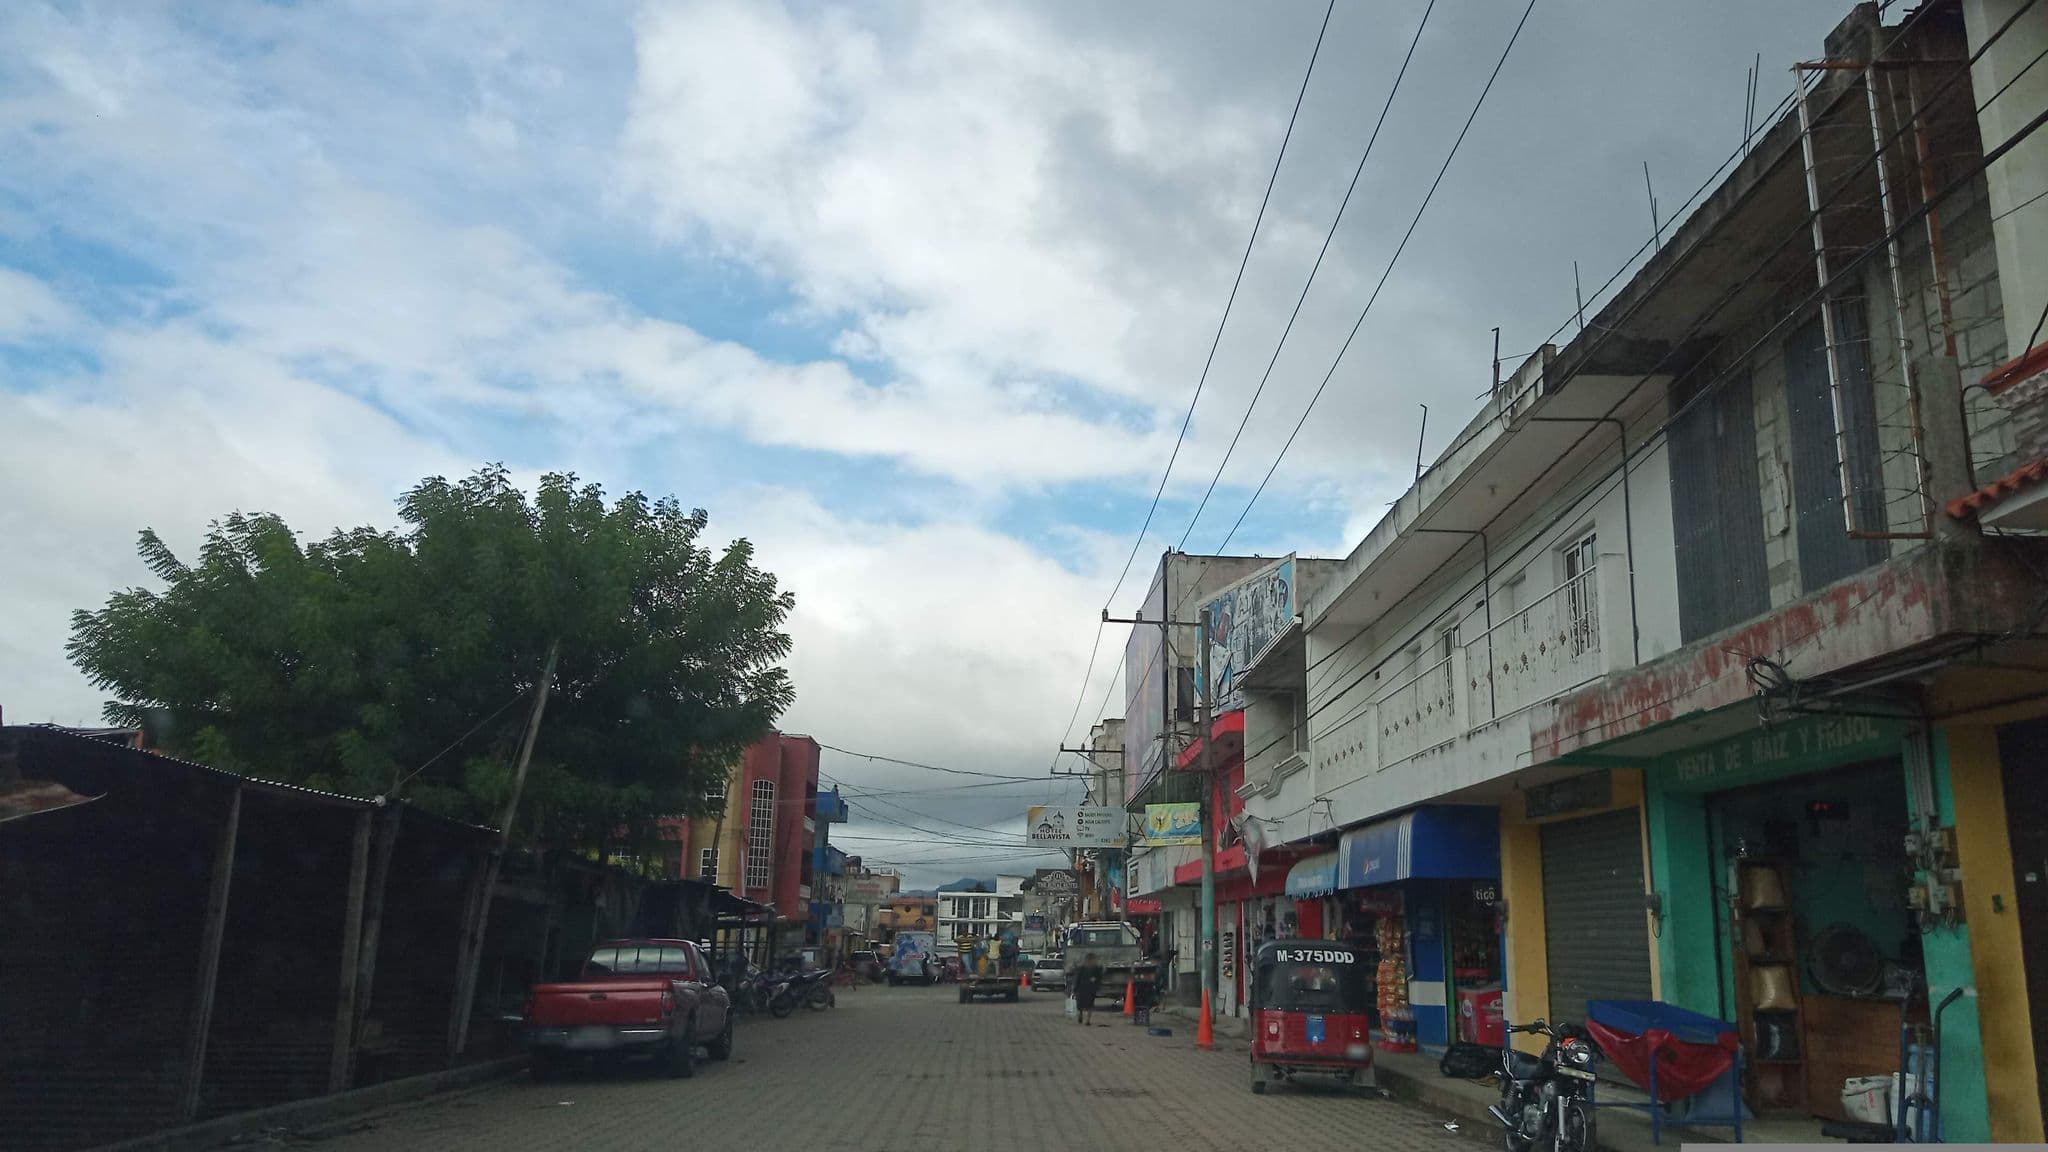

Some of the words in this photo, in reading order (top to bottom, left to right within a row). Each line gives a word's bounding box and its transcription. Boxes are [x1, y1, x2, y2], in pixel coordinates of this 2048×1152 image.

[1676, 751, 1716, 781] VENTA
[1724, 743, 1742, 771] DE
[1752, 731, 1790, 765] MAIZ
[1798, 726, 1809, 753] Y
[1816, 716, 1880, 752] FRIJOL
[1276, 949, 1355, 964] M-375DDD
